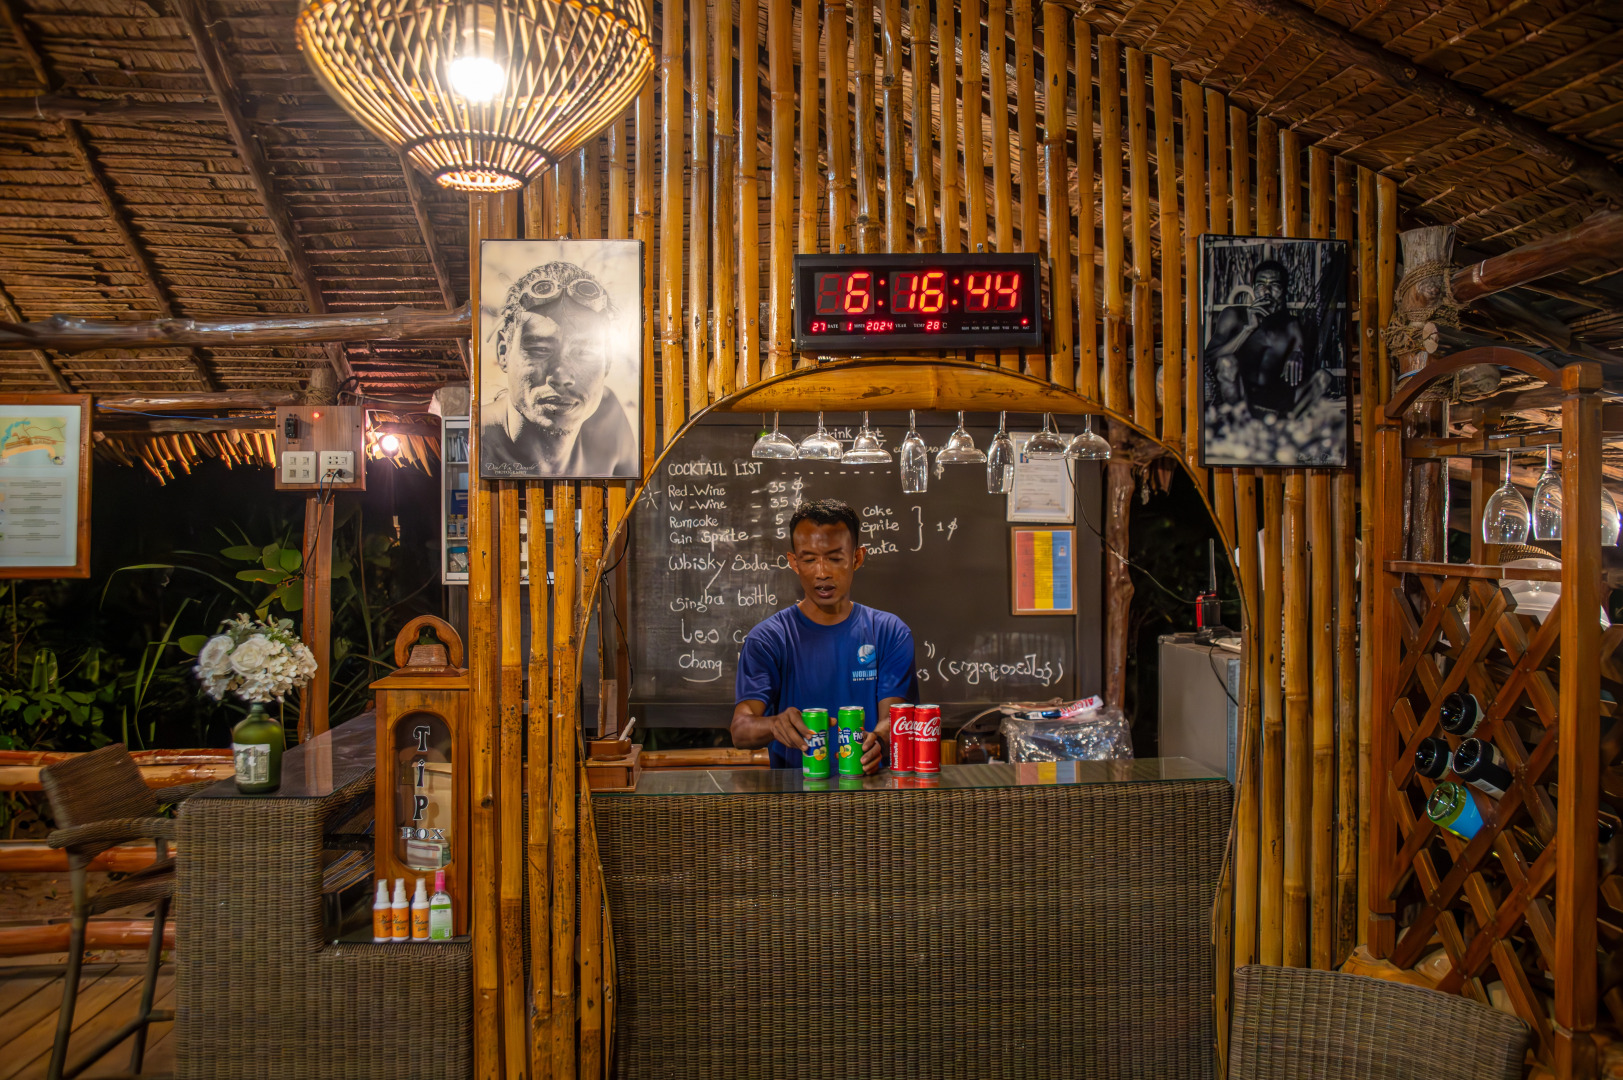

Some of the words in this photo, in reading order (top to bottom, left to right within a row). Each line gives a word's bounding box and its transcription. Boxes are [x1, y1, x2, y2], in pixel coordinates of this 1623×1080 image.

[812, 322, 826, 332] 27
[866, 321, 893, 331] 2024
[926, 321, 939, 330] 28
[668, 462, 727, 476] COCKTAIL
[735, 462, 764, 476] LIST
[768, 482, 786, 494] 35
[770, 496, 789, 508] 35
[862, 505, 893, 517] Coke
[775, 513, 784, 525] 5
[669, 531, 692, 544] Gin
[701, 528, 749, 552] Sprite
[775, 527, 786, 540] 5
[668, 553, 726, 589] Whisky
[737, 584, 778, 606] bottle
[681, 618, 719, 644] Leo
[678, 650, 722, 682] Chang
[401, 826, 445, 840] BOX
